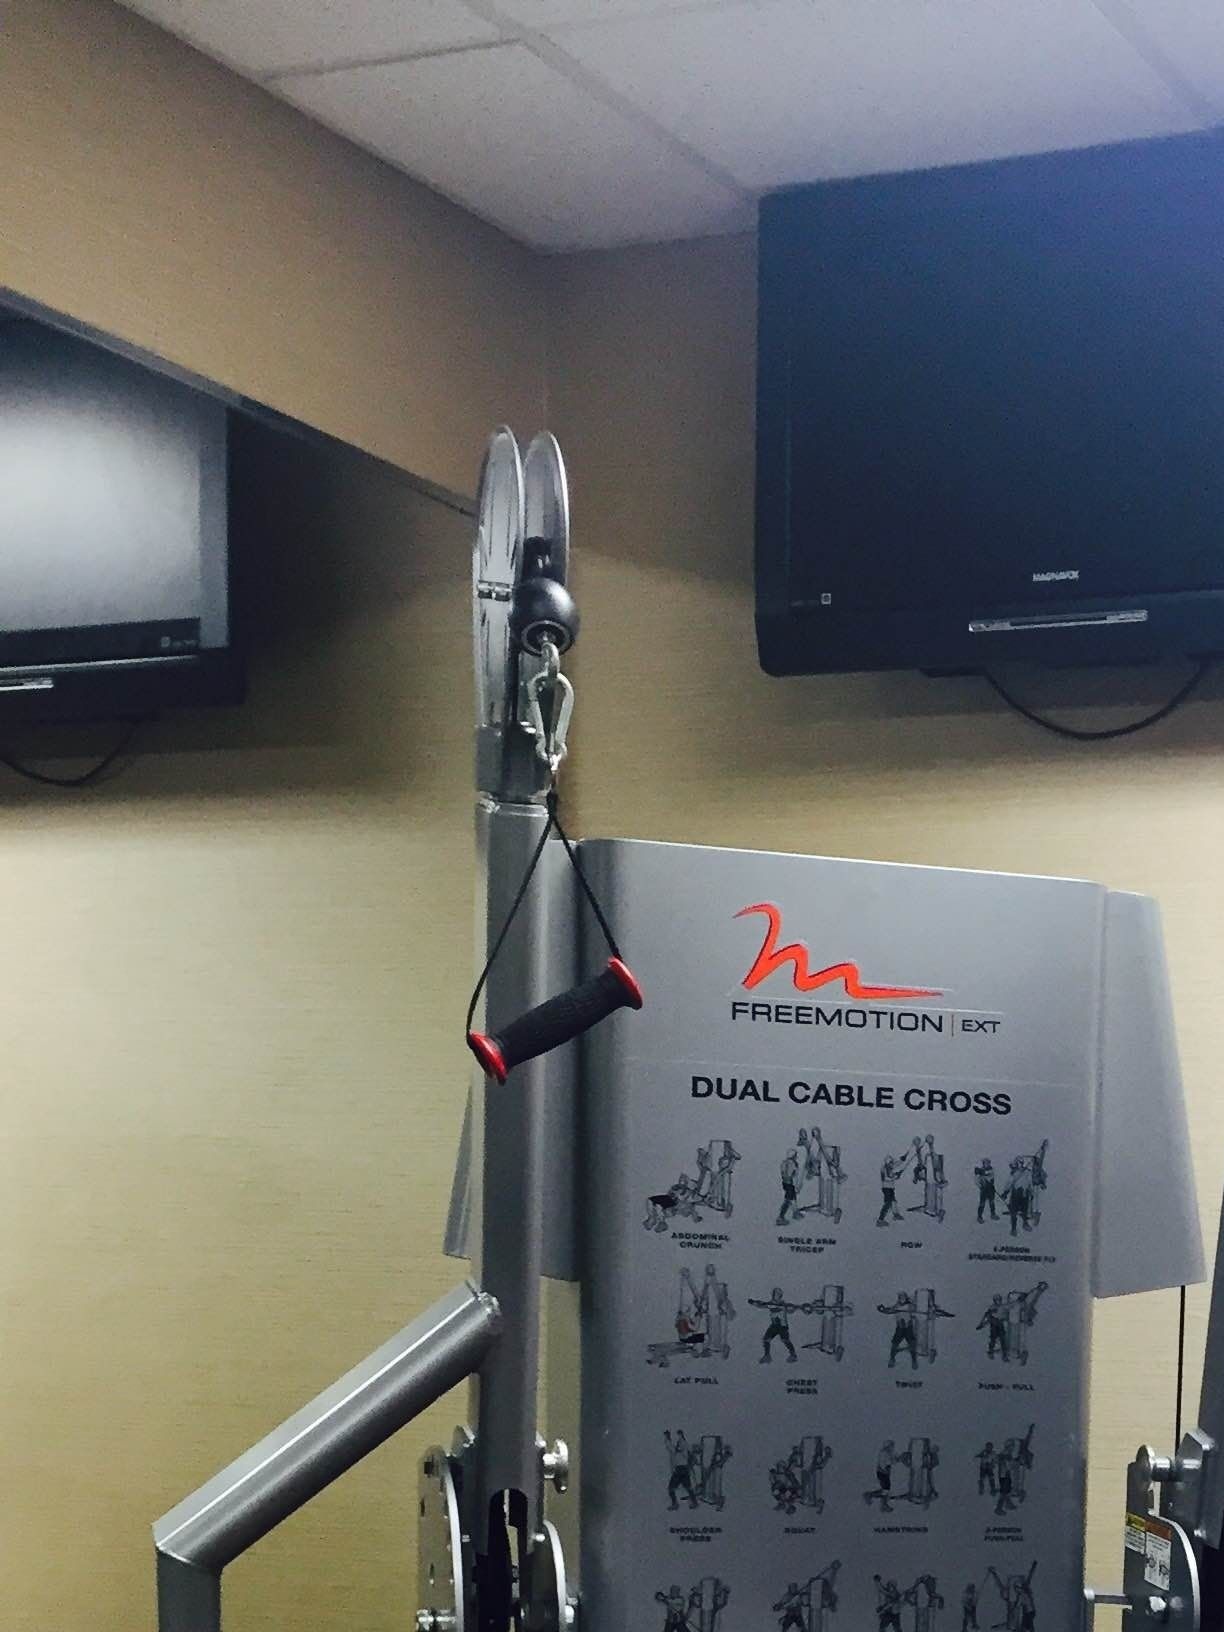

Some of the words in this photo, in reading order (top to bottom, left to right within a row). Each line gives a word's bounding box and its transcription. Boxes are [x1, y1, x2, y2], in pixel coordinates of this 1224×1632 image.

[731, 1001, 943, 1033] FREEMOTION
[961, 1018, 1001, 1034] EXT
[690, 1075, 780, 1103] DUAL
[788, 1080, 894, 1109] CABLE
[903, 1088, 1012, 1115] CROSS
